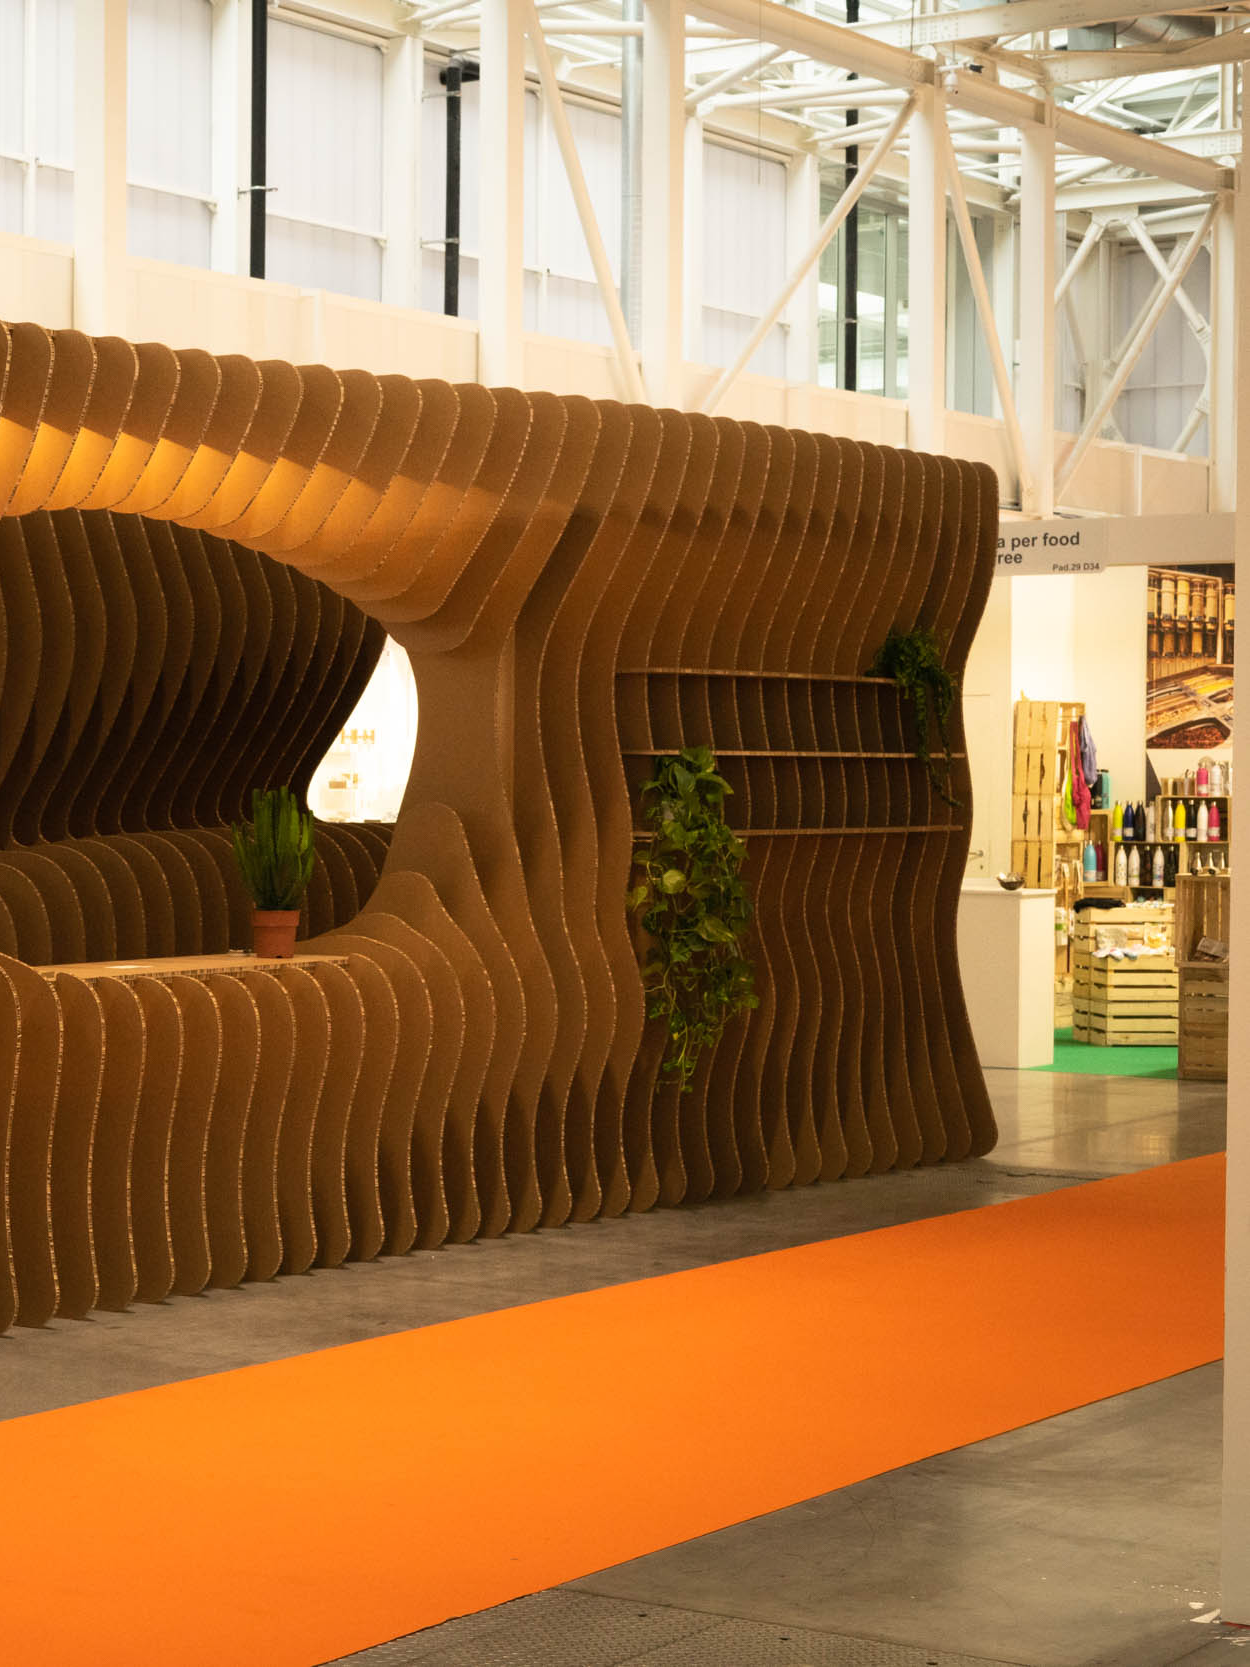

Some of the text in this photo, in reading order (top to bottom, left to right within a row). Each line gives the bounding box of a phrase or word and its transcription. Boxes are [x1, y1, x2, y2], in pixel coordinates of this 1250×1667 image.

[1011, 536, 1038, 551] per
[1042, 531, 1080, 546] food
[997, 553, 1023, 564] ree
[1083, 562, 1100, 570] D34
